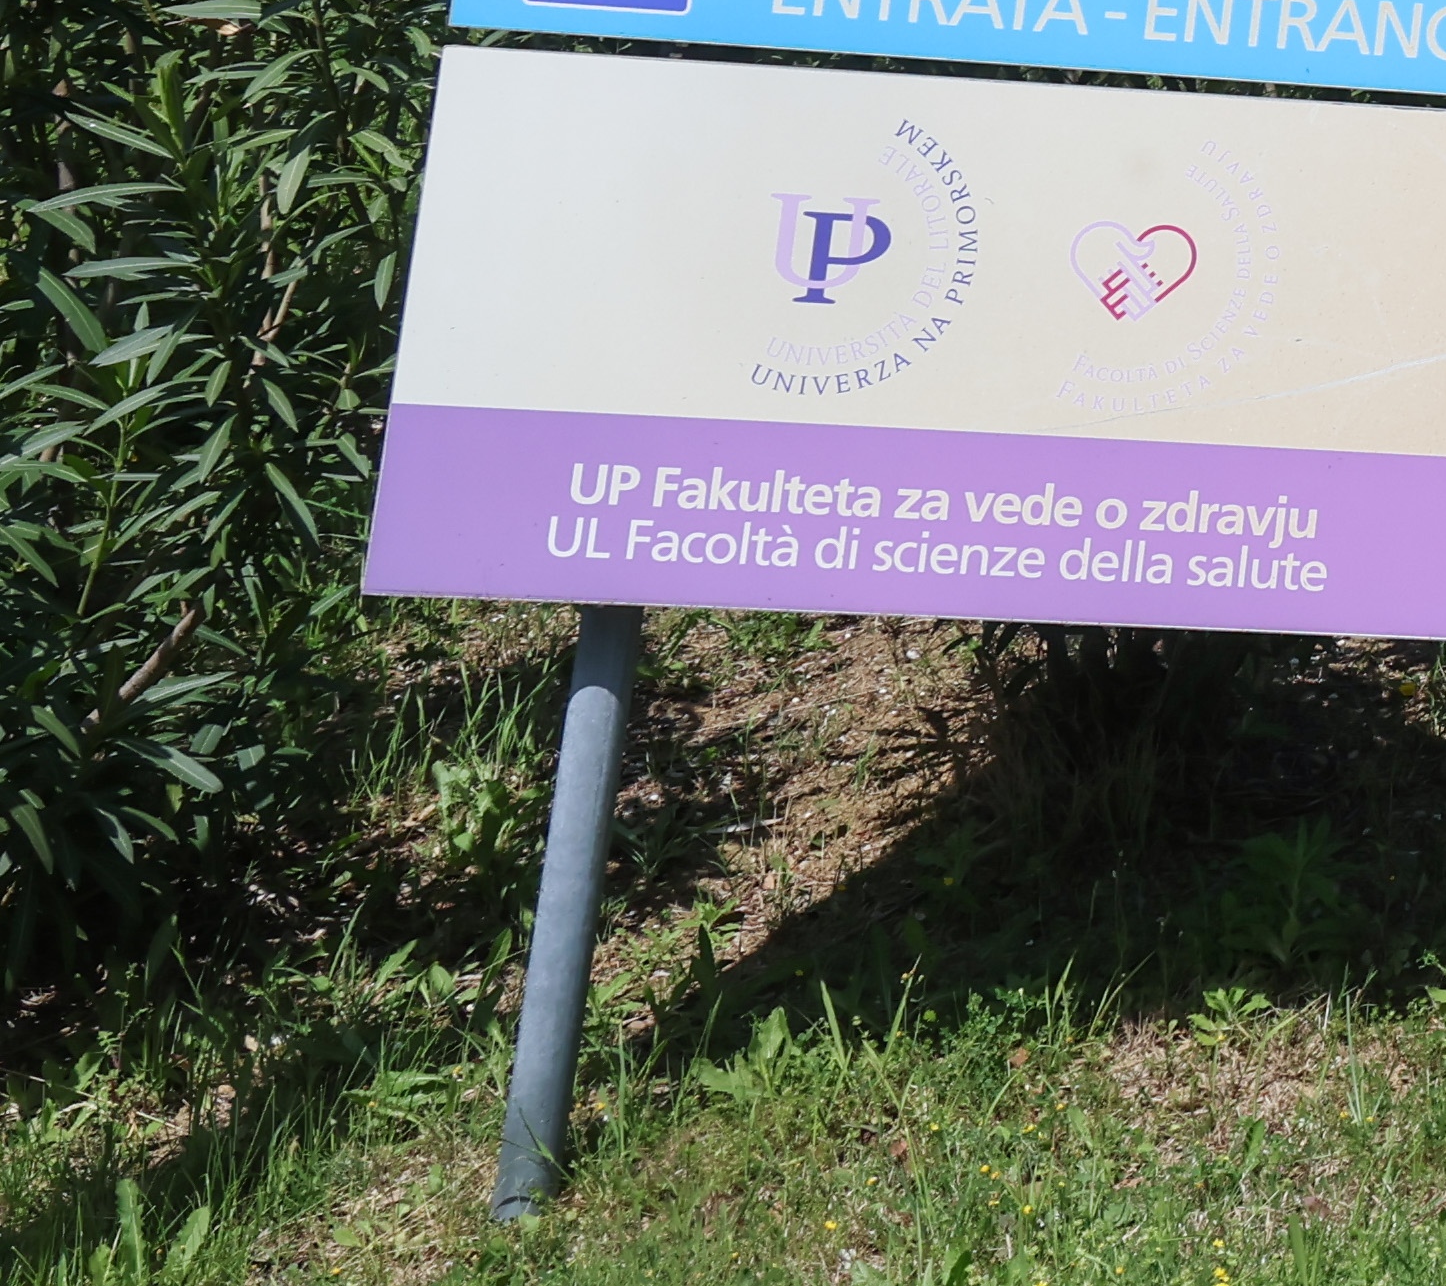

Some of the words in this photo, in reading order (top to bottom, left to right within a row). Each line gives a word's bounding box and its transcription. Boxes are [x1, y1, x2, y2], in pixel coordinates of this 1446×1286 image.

[878, 145, 949, 250] LITORALE
[894, 119, 979, 305] PRIMORSKEM
[1234, 222, 1251, 279] DELLA
[911, 262, 947, 309] DEL
[766, 311, 918, 366] UNIVERSITÀ
[912, 316, 952, 352] NA
[1217, 346, 1245, 374] ZA
[1243, 274, 1279, 338] VEDE
[751, 352, 912, 395] UNIVERZA
[570, 462, 641, 506] UP
[652, 466, 882, 518] Fakulteta
[893, 488, 950, 521] za
[964, 482, 1083, 528] vede
[1095, 498, 1128, 530] o
[1139, 489, 1318, 548] zdravju
[547, 515, 611, 559] UL
[625, 519, 799, 567] Facoltà
[814, 525, 861, 570] di
[872, 530, 1046, 579] scienze
[1059, 537, 1172, 585] della
[1186, 544, 1328, 592] salute
